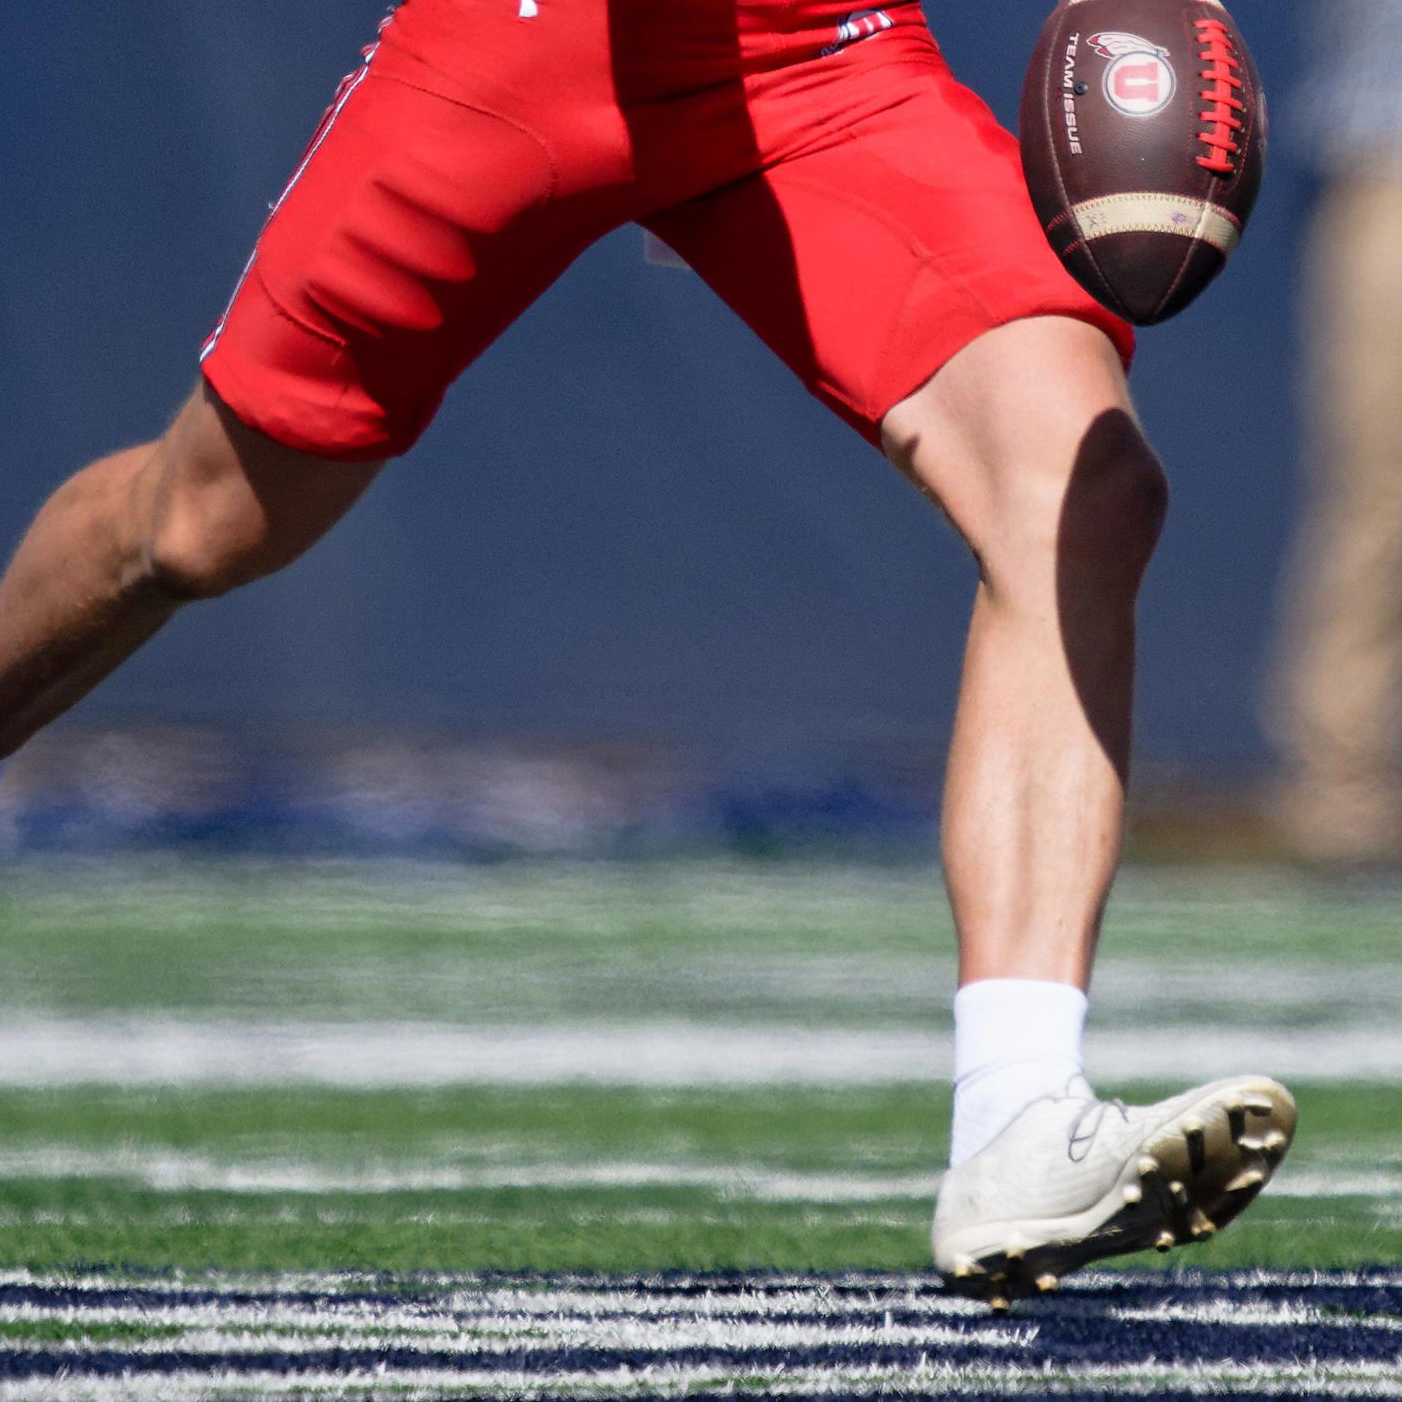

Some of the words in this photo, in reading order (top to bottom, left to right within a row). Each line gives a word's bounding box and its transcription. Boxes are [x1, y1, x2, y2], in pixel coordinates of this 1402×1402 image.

[1063, 32, 1080, 88] TEAM
[1113, 61, 1159, 103] U
[1063, 93, 1083, 155] ISSUE
